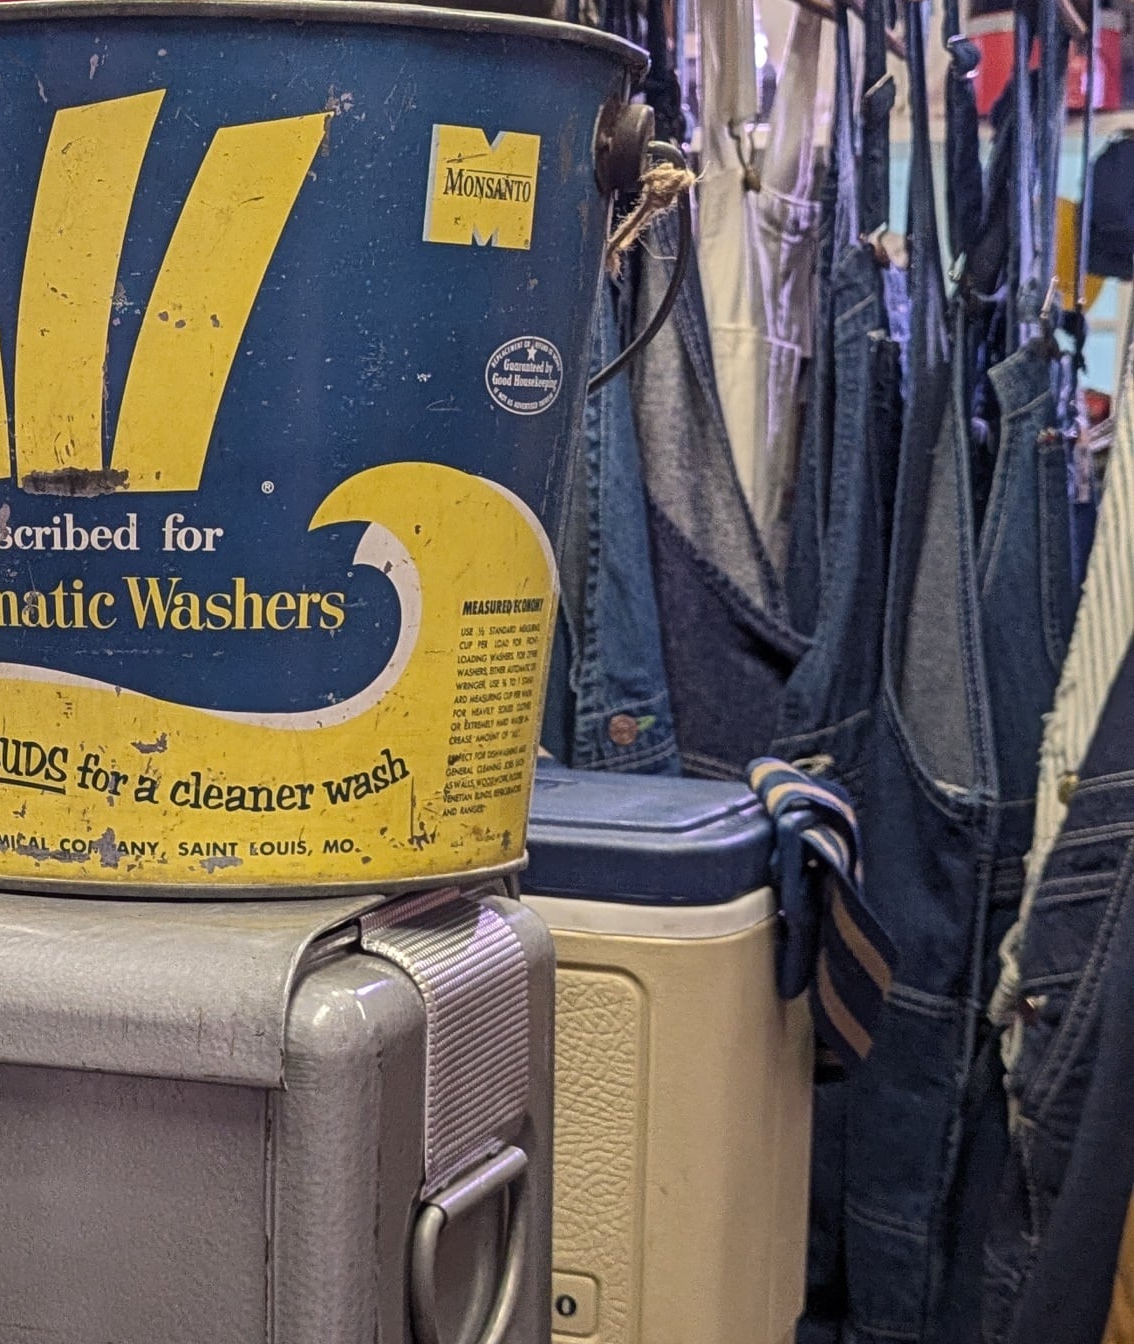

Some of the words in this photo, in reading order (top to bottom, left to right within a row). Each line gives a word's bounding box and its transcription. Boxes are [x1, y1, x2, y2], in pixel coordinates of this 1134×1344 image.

[442, 166, 532, 203] MONSANTO
[503, 358, 544, 373] Guaranteed
[545, 360, 553, 379] by
[492, 372, 512, 386] Good
[514, 374, 558, 393] Housekeeping
[162, 513, 224, 553] for
[122, 576, 346, 631] Washers
[462, 599, 513, 616] MEASURED
[461, 627, 474, 637] USE
[459, 641, 473, 650] CUP
[457, 654, 488, 664] LOADING
[77, 753, 129, 796] for
[134, 774, 159, 805] a
[170, 772, 315, 812] cleaner
[323, 748, 410, 805] wash
[60, 837, 165, 857] COMANY,
[178, 841, 238, 857] SAINT
[250, 841, 313, 856] LOUIS,
[323, 839, 361, 854] MO.
